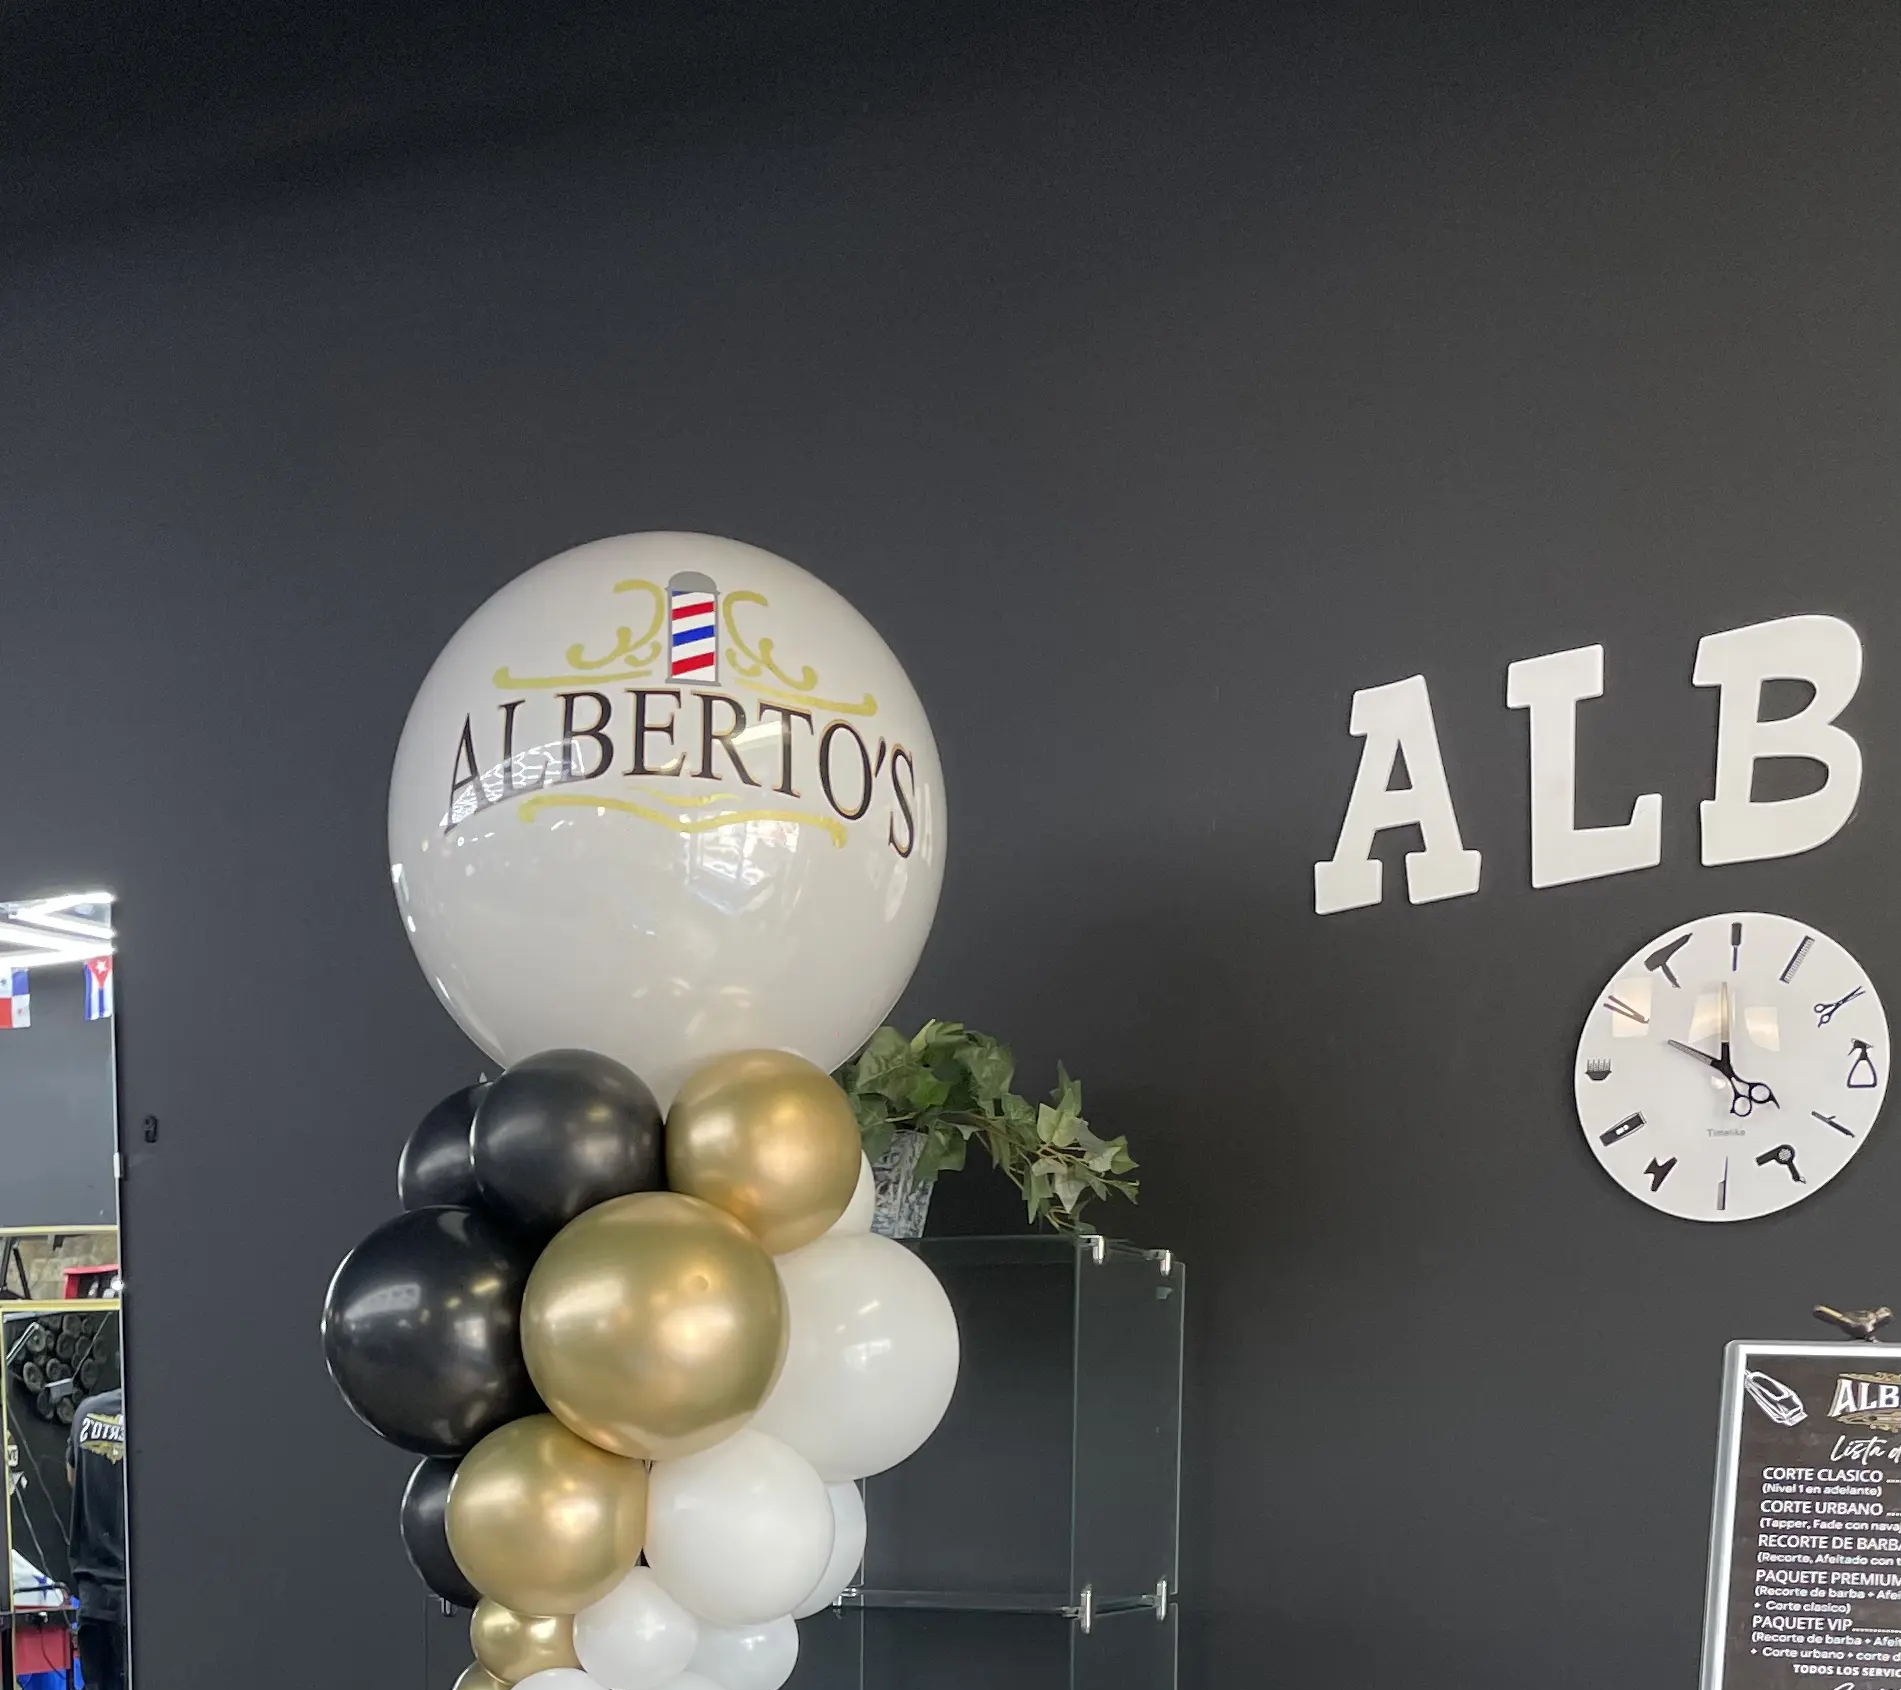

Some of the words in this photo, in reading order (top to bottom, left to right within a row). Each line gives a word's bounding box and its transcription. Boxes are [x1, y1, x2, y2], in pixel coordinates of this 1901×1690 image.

[443, 688, 917, 858] ALBERTO'S
[1830, 1435, 1888, 1466] Lista
[1763, 1467, 1814, 1481] CORTE
[1817, 1469, 1884, 1483] CLASICO
[1762, 1483, 1797, 1494] (Nivel
[1798, 1484, 1804, 1493] 1
[1805, 1486, 1822, 1494] en
[1823, 1485, 1883, 1497] adelante)
[1760, 1500, 1812, 1514] CORTE
[1815, 1501, 1884, 1516] URBANO
[1759, 1517, 1812, 1530] (Tapper,
[1813, 1519, 1843, 1530] Fade
[1845, 1521, 1869, 1530] con
[1758, 1534, 1828, 1549] RECORTE
[1831, 1536, 1853, 1550] DE
[1757, 1552, 1814, 1564] (Recorte,
[1815, 1554, 1869, 1565] Afeitado
[1870, 1557, 1894, 1566] con
[1756, 1569, 1828, 1585] PAQUETE
[1755, 1585, 1808, 1597] (Recorte
[1810, 1587, 1826, 1597] de
[1828, 1588, 1866, 1599] barba
[1765, 1601, 1802, 1611] Corte
[1803, 1602, 1851, 1615] clasico)
[1752, 1615, 1825, 1631] PAQUETE
[1827, 1618, 1853, 1631] VIP
[1751, 1632, 1805, 1643] (Recorte
[1807, 1634, 1823, 1644] de
[1825, 1635, 1862, 1645] barba
[1762, 1647, 1798, 1658] Corte
[1800, 1649, 1845, 1659] urbano
[1856, 1652, 1890, 1661] corte
[1793, 1664, 1834, 1675] TODOS
[1836, 1666, 1859, 1676] LOS
